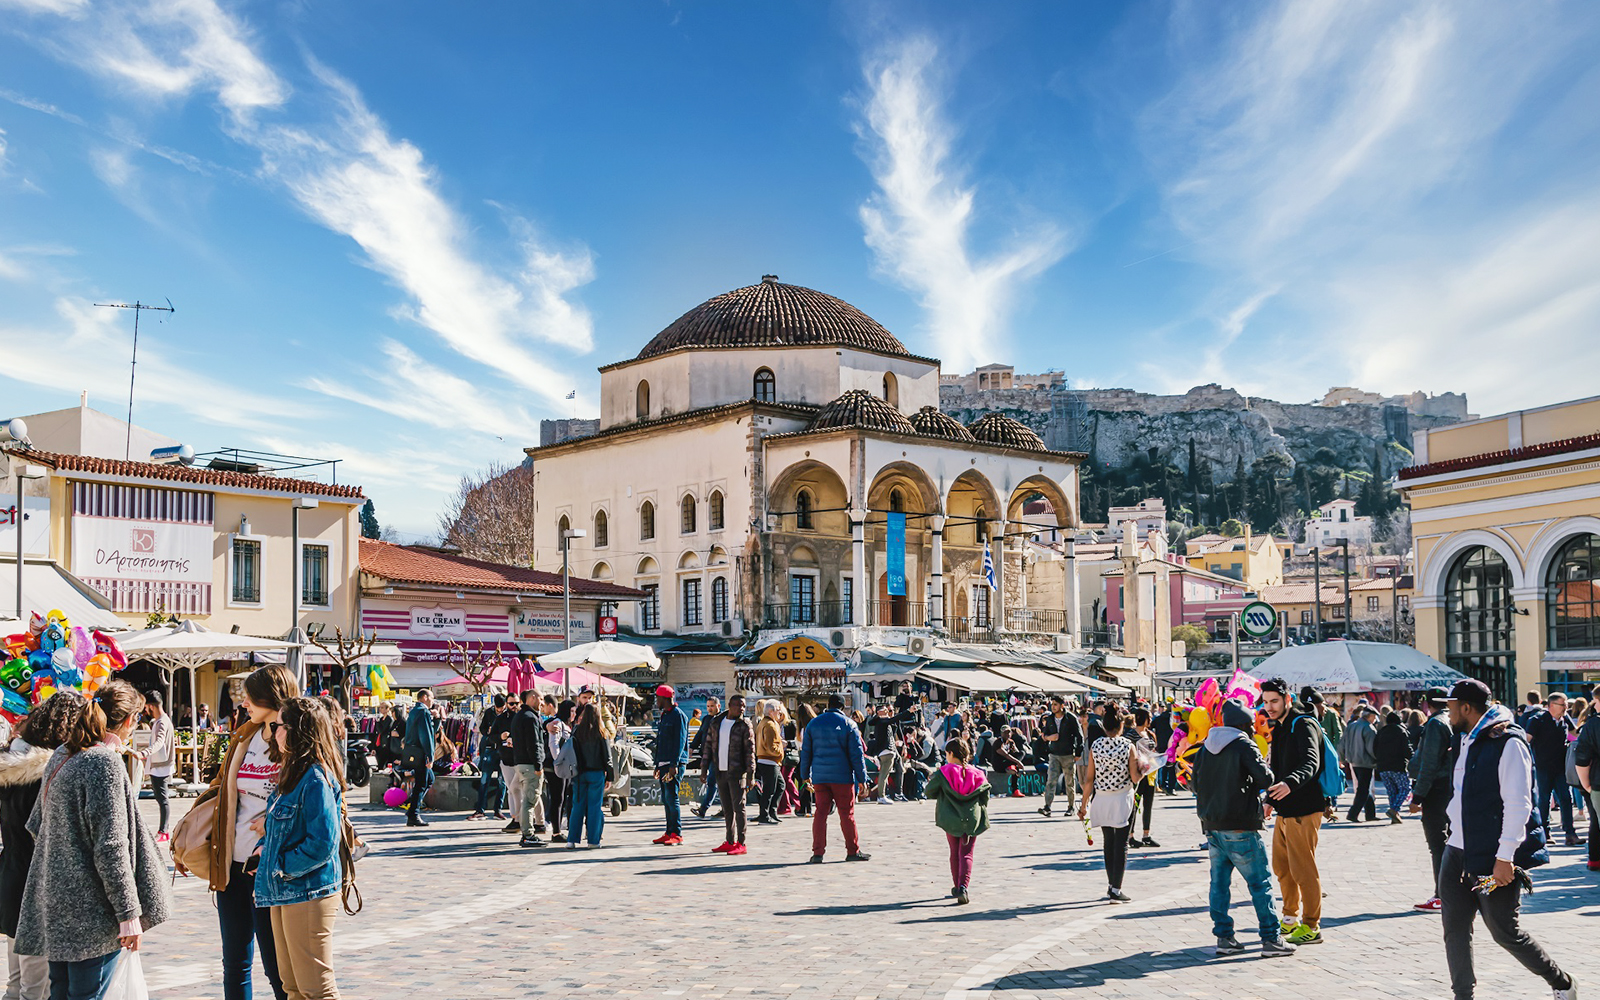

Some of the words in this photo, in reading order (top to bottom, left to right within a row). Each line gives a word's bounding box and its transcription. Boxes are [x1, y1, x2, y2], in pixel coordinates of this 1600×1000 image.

[527, 618, 560, 628] ADRIANOS
[562, 620, 584, 628] TAVEL
[417, 653, 437, 662] gelato
[776, 645, 815, 661] GES
